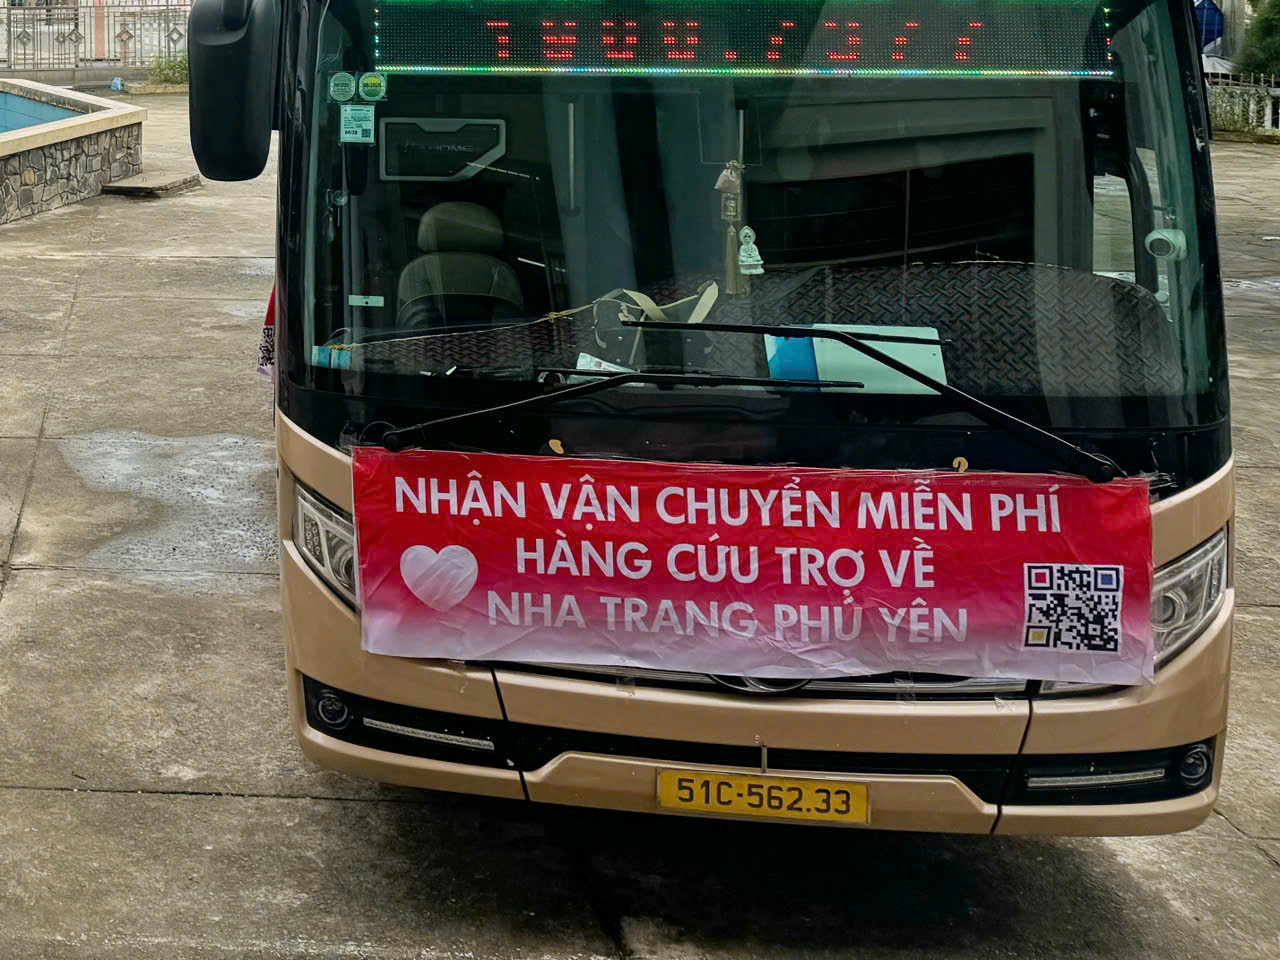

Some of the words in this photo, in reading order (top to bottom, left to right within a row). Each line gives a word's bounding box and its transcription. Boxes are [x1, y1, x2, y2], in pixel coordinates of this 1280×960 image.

[395, 469, 526, 526] NHẬN
[541, 473, 640, 531] VẬN
[656, 476, 840, 528] CHUYỂN
[857, 479, 973, 531] MIỄN
[989, 484, 1061, 533] PHÍ
[516, 529, 652, 580] HÀNG
[667, 533, 759, 584] CỨU
[775, 545, 865, 597] TRỢ
[879, 536, 935, 588] VỀ
[488, 590, 586, 629] NHA
[600, 596, 758, 640] TRANG
[774, 595, 862, 642] PHÚ
[879, 597, 967, 643] YÊN
[677, 778, 851, 816] 51C-562.33
